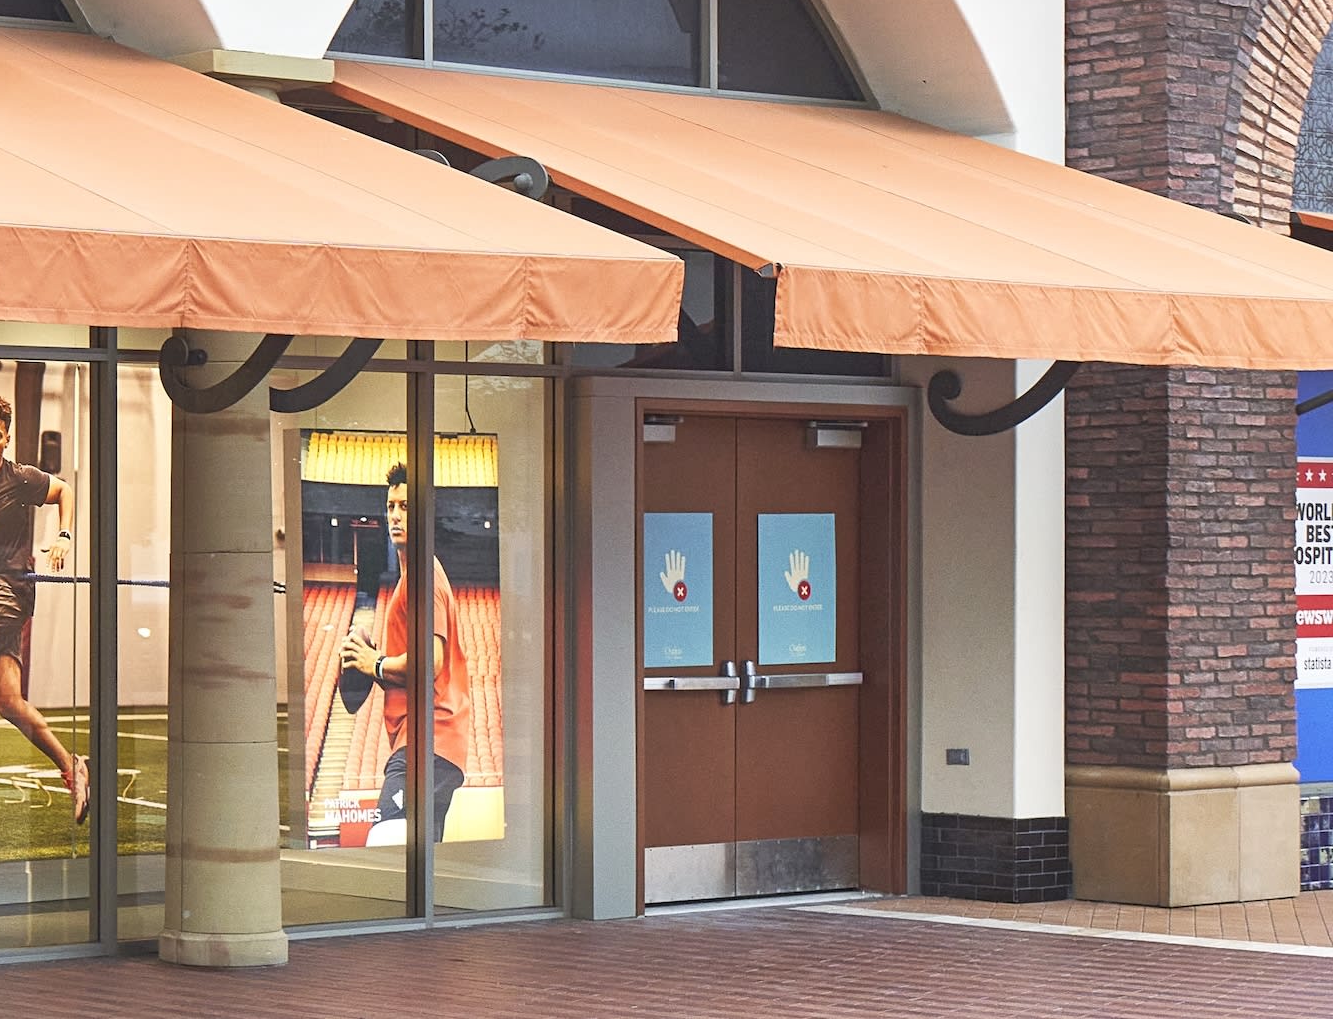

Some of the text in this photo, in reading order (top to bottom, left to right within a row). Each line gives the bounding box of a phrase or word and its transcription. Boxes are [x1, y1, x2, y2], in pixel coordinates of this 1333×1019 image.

[1297, 503, 1333, 521] WORL
[1306, 525, 1333, 543] BES
[1309, 571, 1333, 584] 2023
[1304, 657, 1332, 670] statista
[325, 799, 360, 809] PATRICK
[325, 808, 381, 823] MAHOMES
